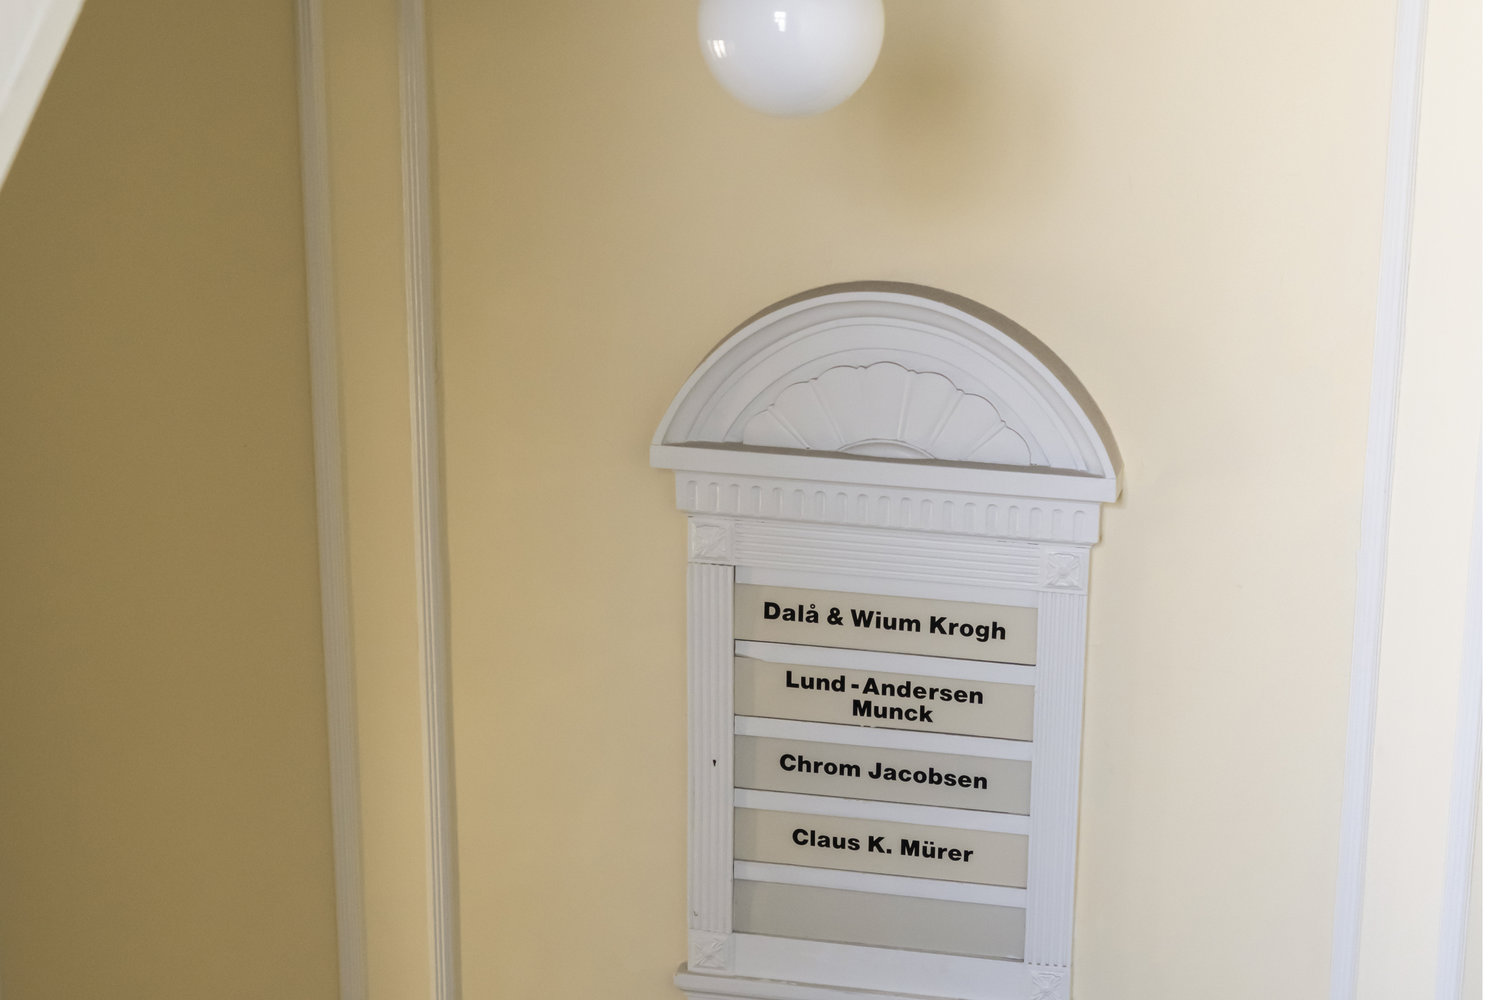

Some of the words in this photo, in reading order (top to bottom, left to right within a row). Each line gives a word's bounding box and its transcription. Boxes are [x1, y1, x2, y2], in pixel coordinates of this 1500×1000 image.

[763, 601, 819, 624] Dalå
[826, 606, 844, 626] &
[850, 608, 921, 632] Wium
[929, 615, 1006, 643] Krogh
[852, 699, 934, 723] Munck
[779, 753, 861, 778] Chrom
[867, 762, 988, 790] Jacobsen
[792, 828, 861, 851] Claus
[867, 835, 892, 855] K.
[900, 838, 974, 863] Mürer
